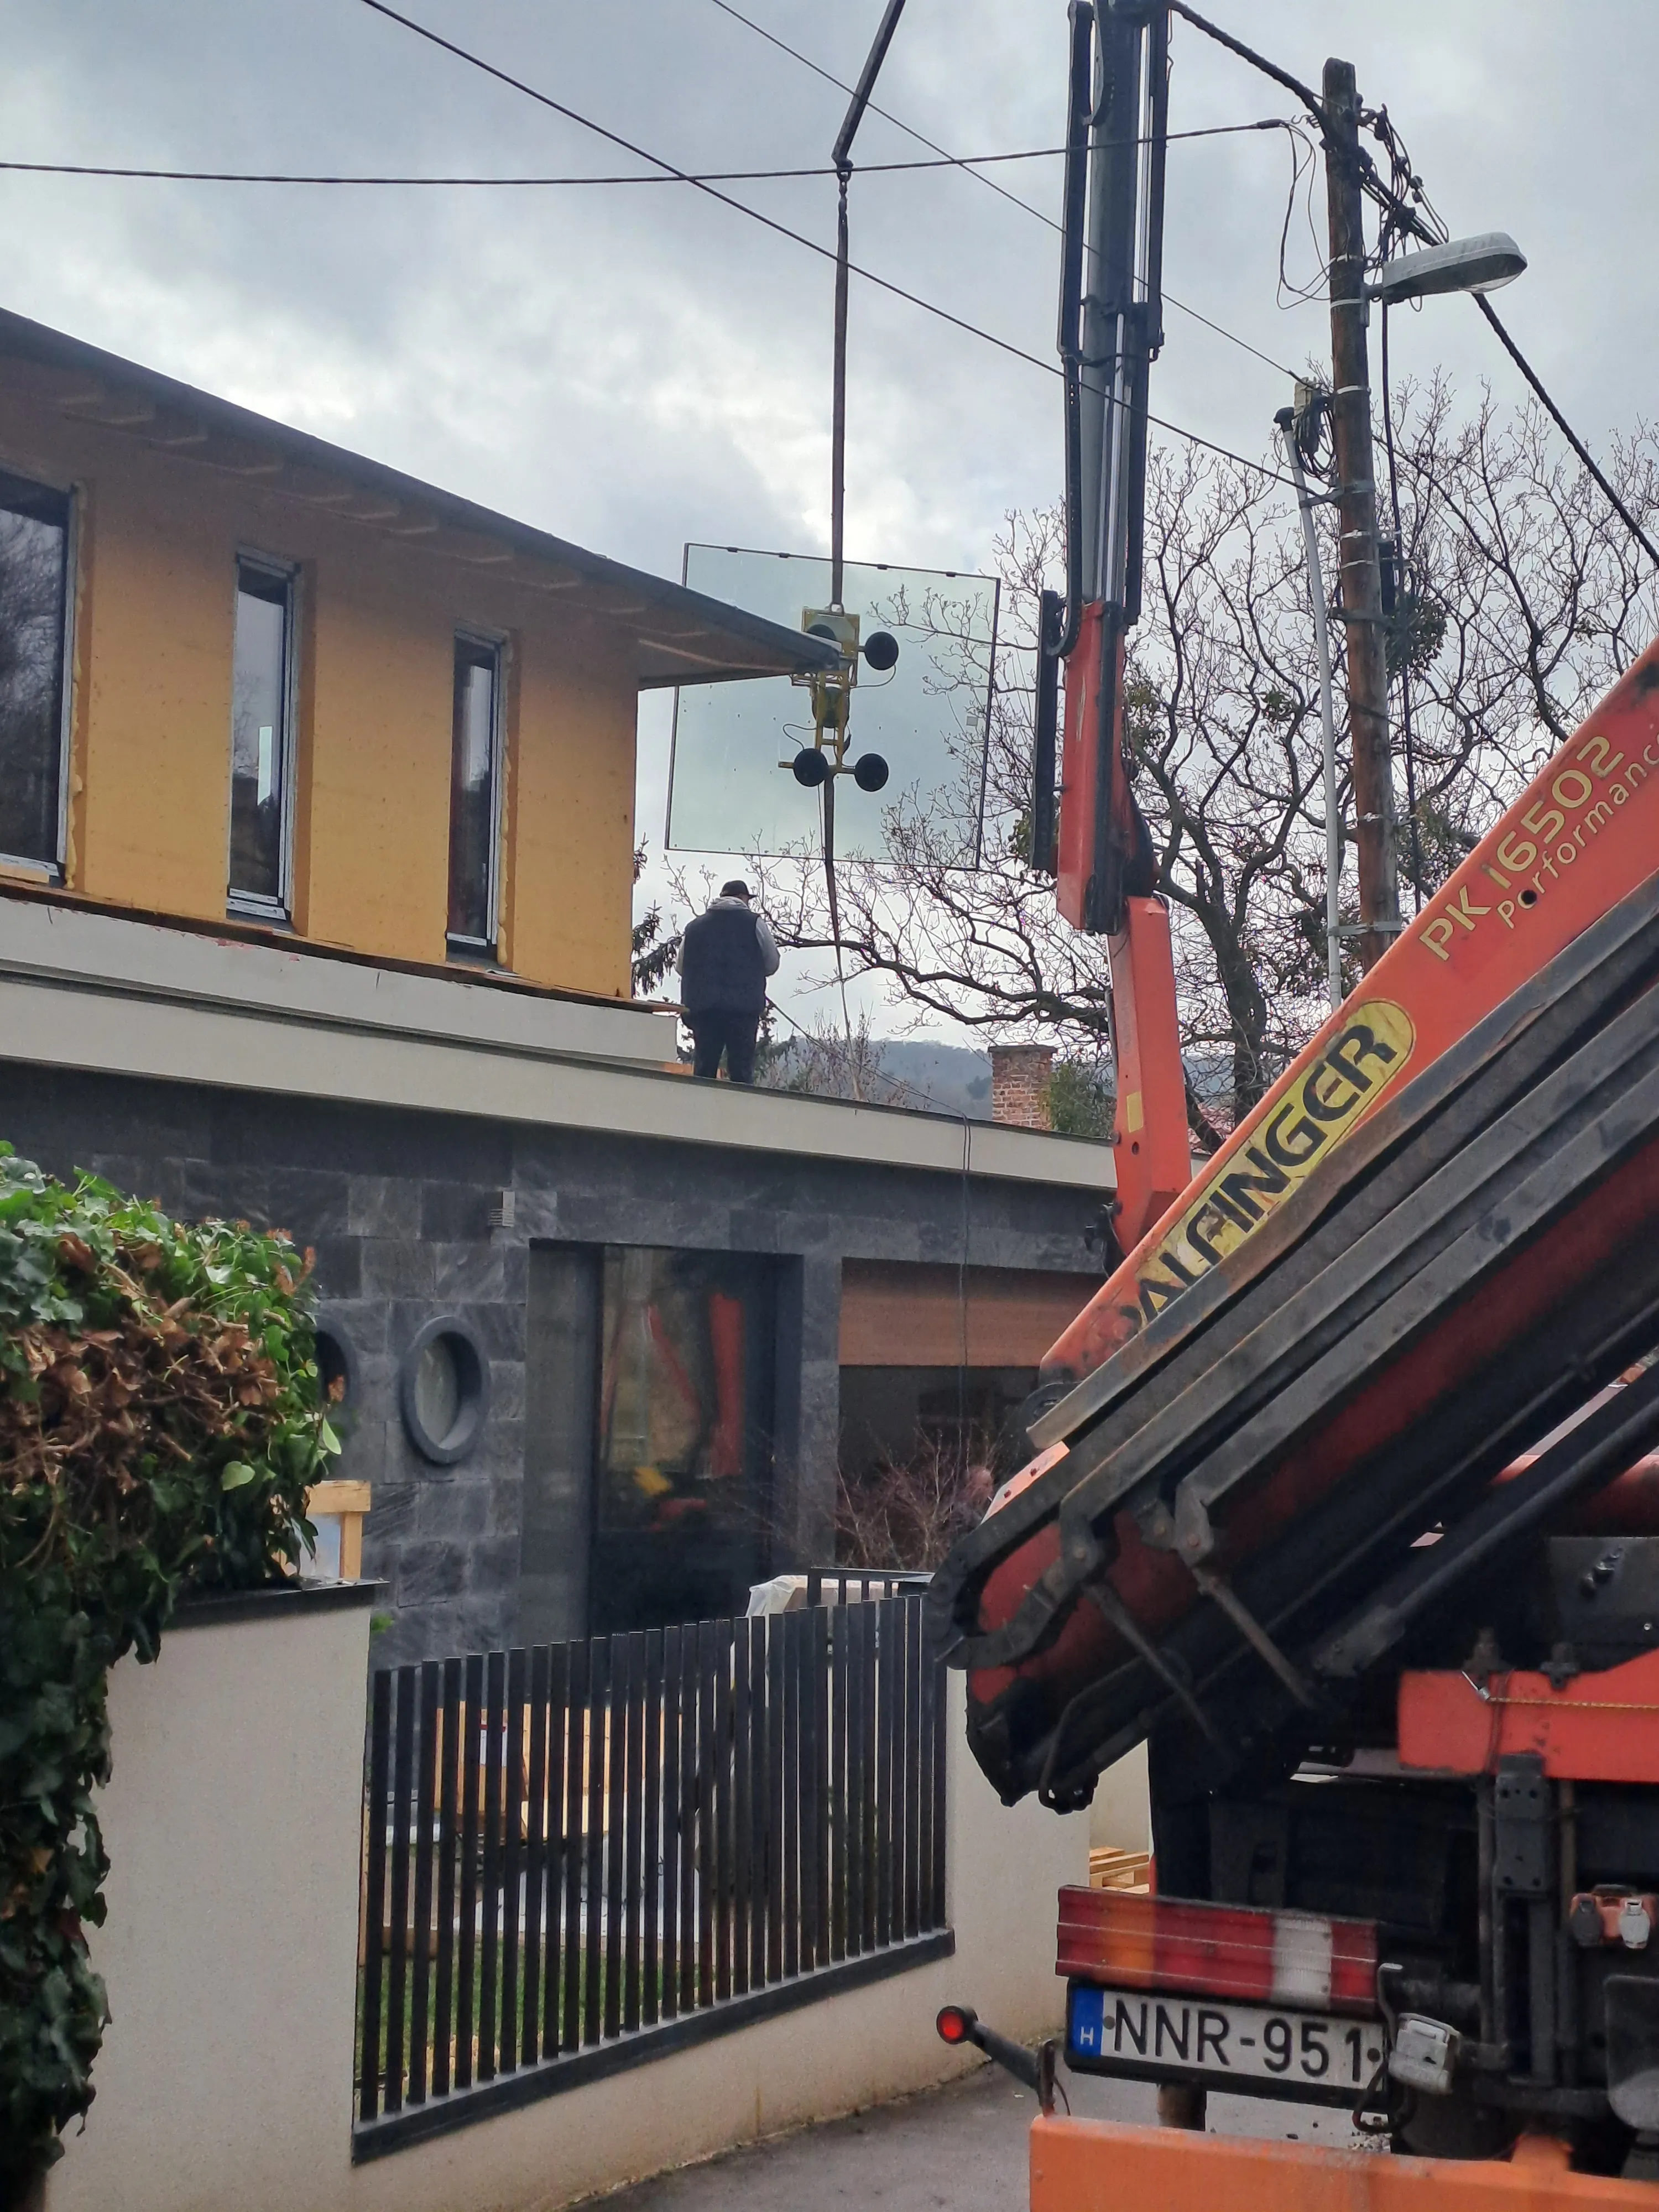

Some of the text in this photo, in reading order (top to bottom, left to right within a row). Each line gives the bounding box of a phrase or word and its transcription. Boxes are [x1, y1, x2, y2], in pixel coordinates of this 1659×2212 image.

[1419, 736, 1625, 962] PK 16502
[1496, 733, 1659, 929] Prformanc
[1080, 2026, 1094, 2046] H
[1114, 1999, 1361, 2083] NNR-951
